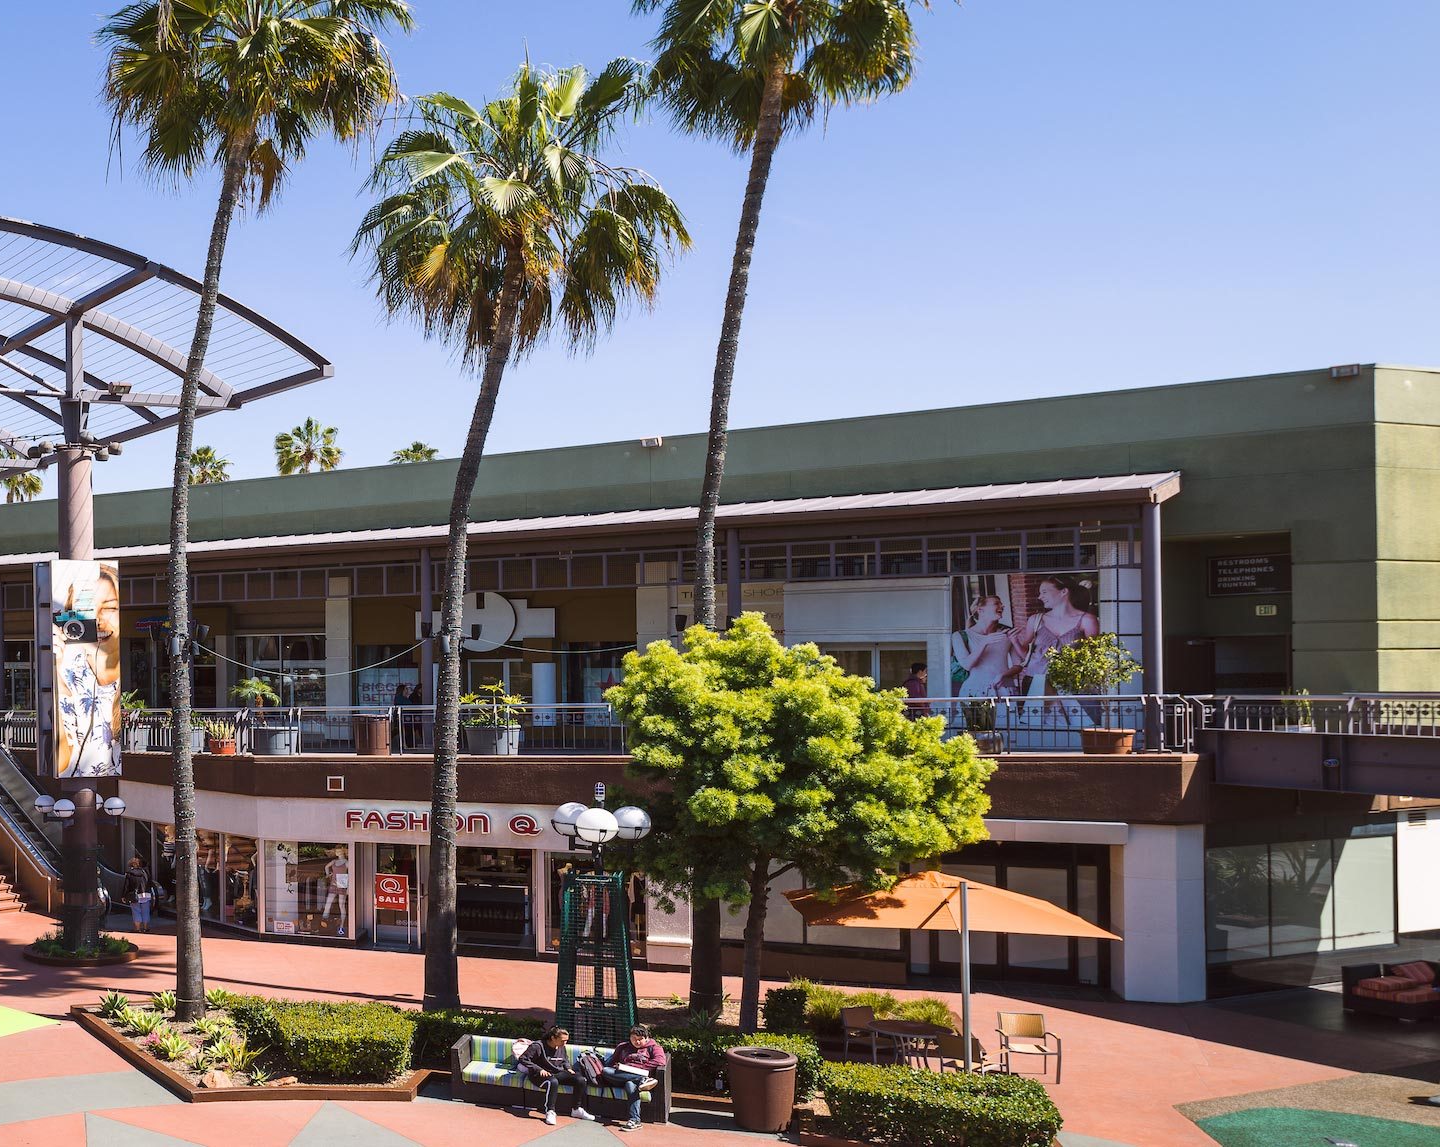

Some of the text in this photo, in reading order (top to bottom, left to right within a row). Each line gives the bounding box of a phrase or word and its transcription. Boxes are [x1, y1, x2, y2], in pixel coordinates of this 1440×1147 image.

[1218, 558, 1269, 566] RESTROOMS
[1218, 567, 1274, 575] TELEPHONES
[345, 810, 544, 837] FASHN Q
[379, 877, 403, 895] Q
[378, 895, 405, 904] SALE
